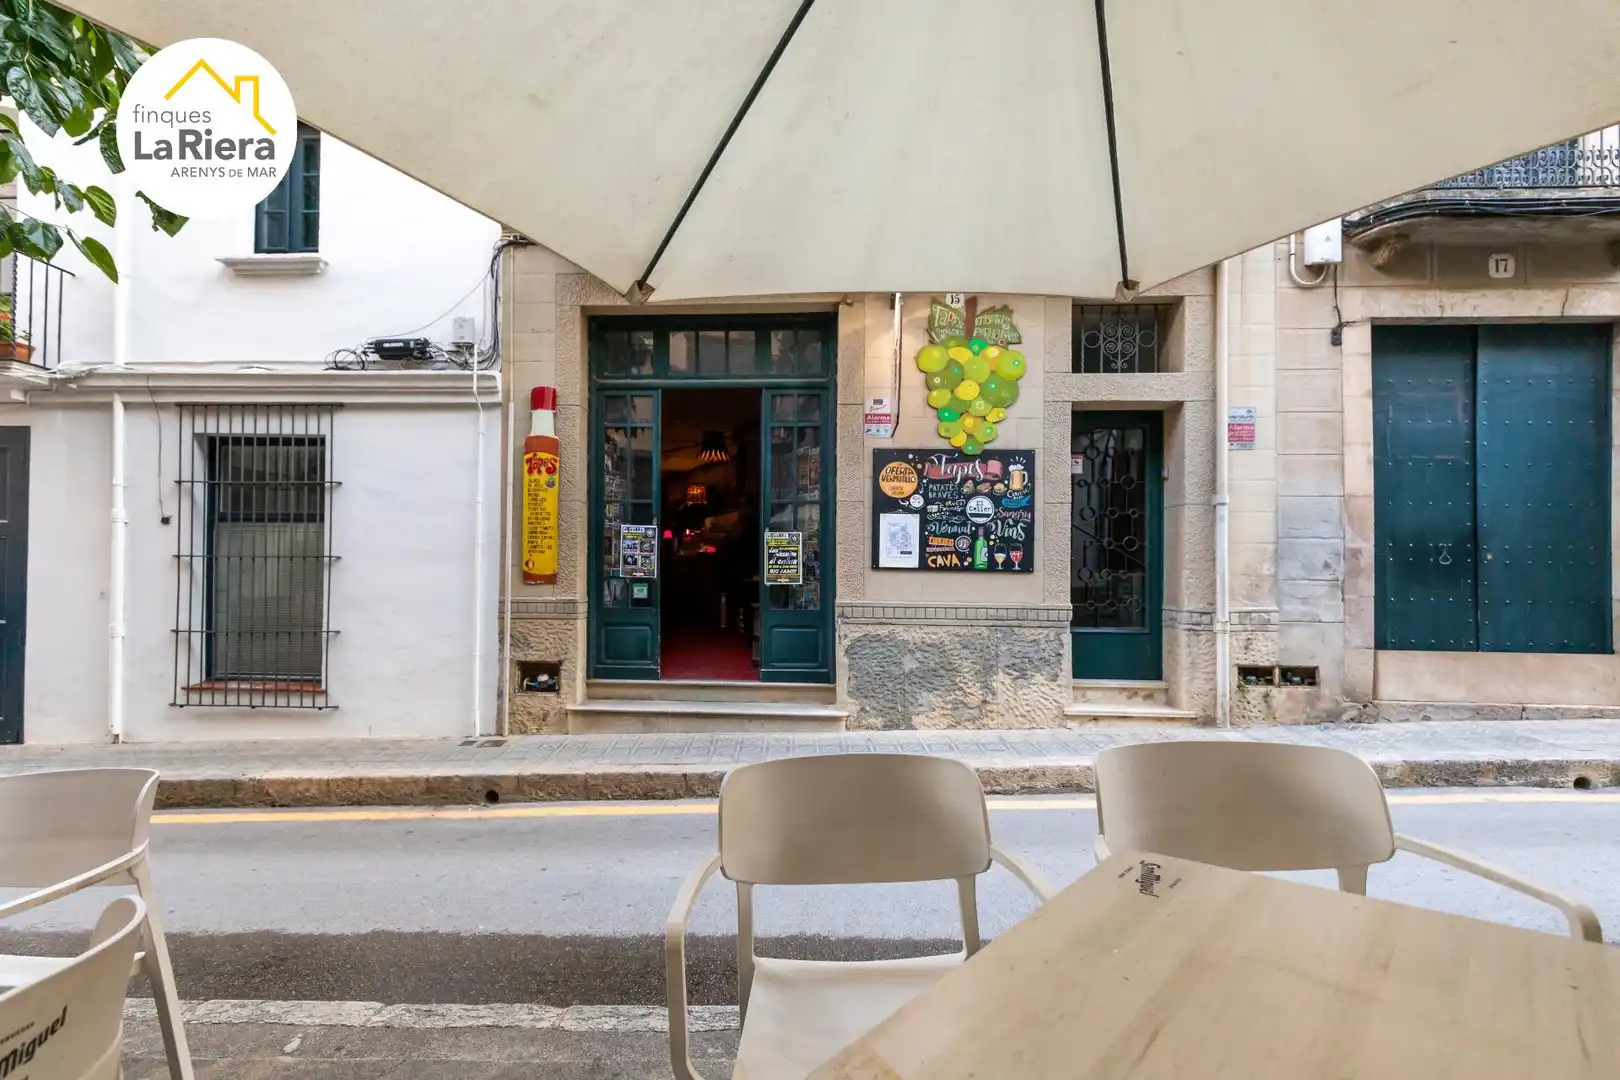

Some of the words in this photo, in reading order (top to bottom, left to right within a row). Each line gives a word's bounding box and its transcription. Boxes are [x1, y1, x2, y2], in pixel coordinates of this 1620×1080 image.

[1495, 258, 1508, 273] 17
[950, 294, 960, 305] 15
[885, 466, 915, 475] OFERTA
[928, 491, 959, 499] BRAVES
[989, 518, 1027, 541] Vins
[927, 553, 961, 568] CAVA
